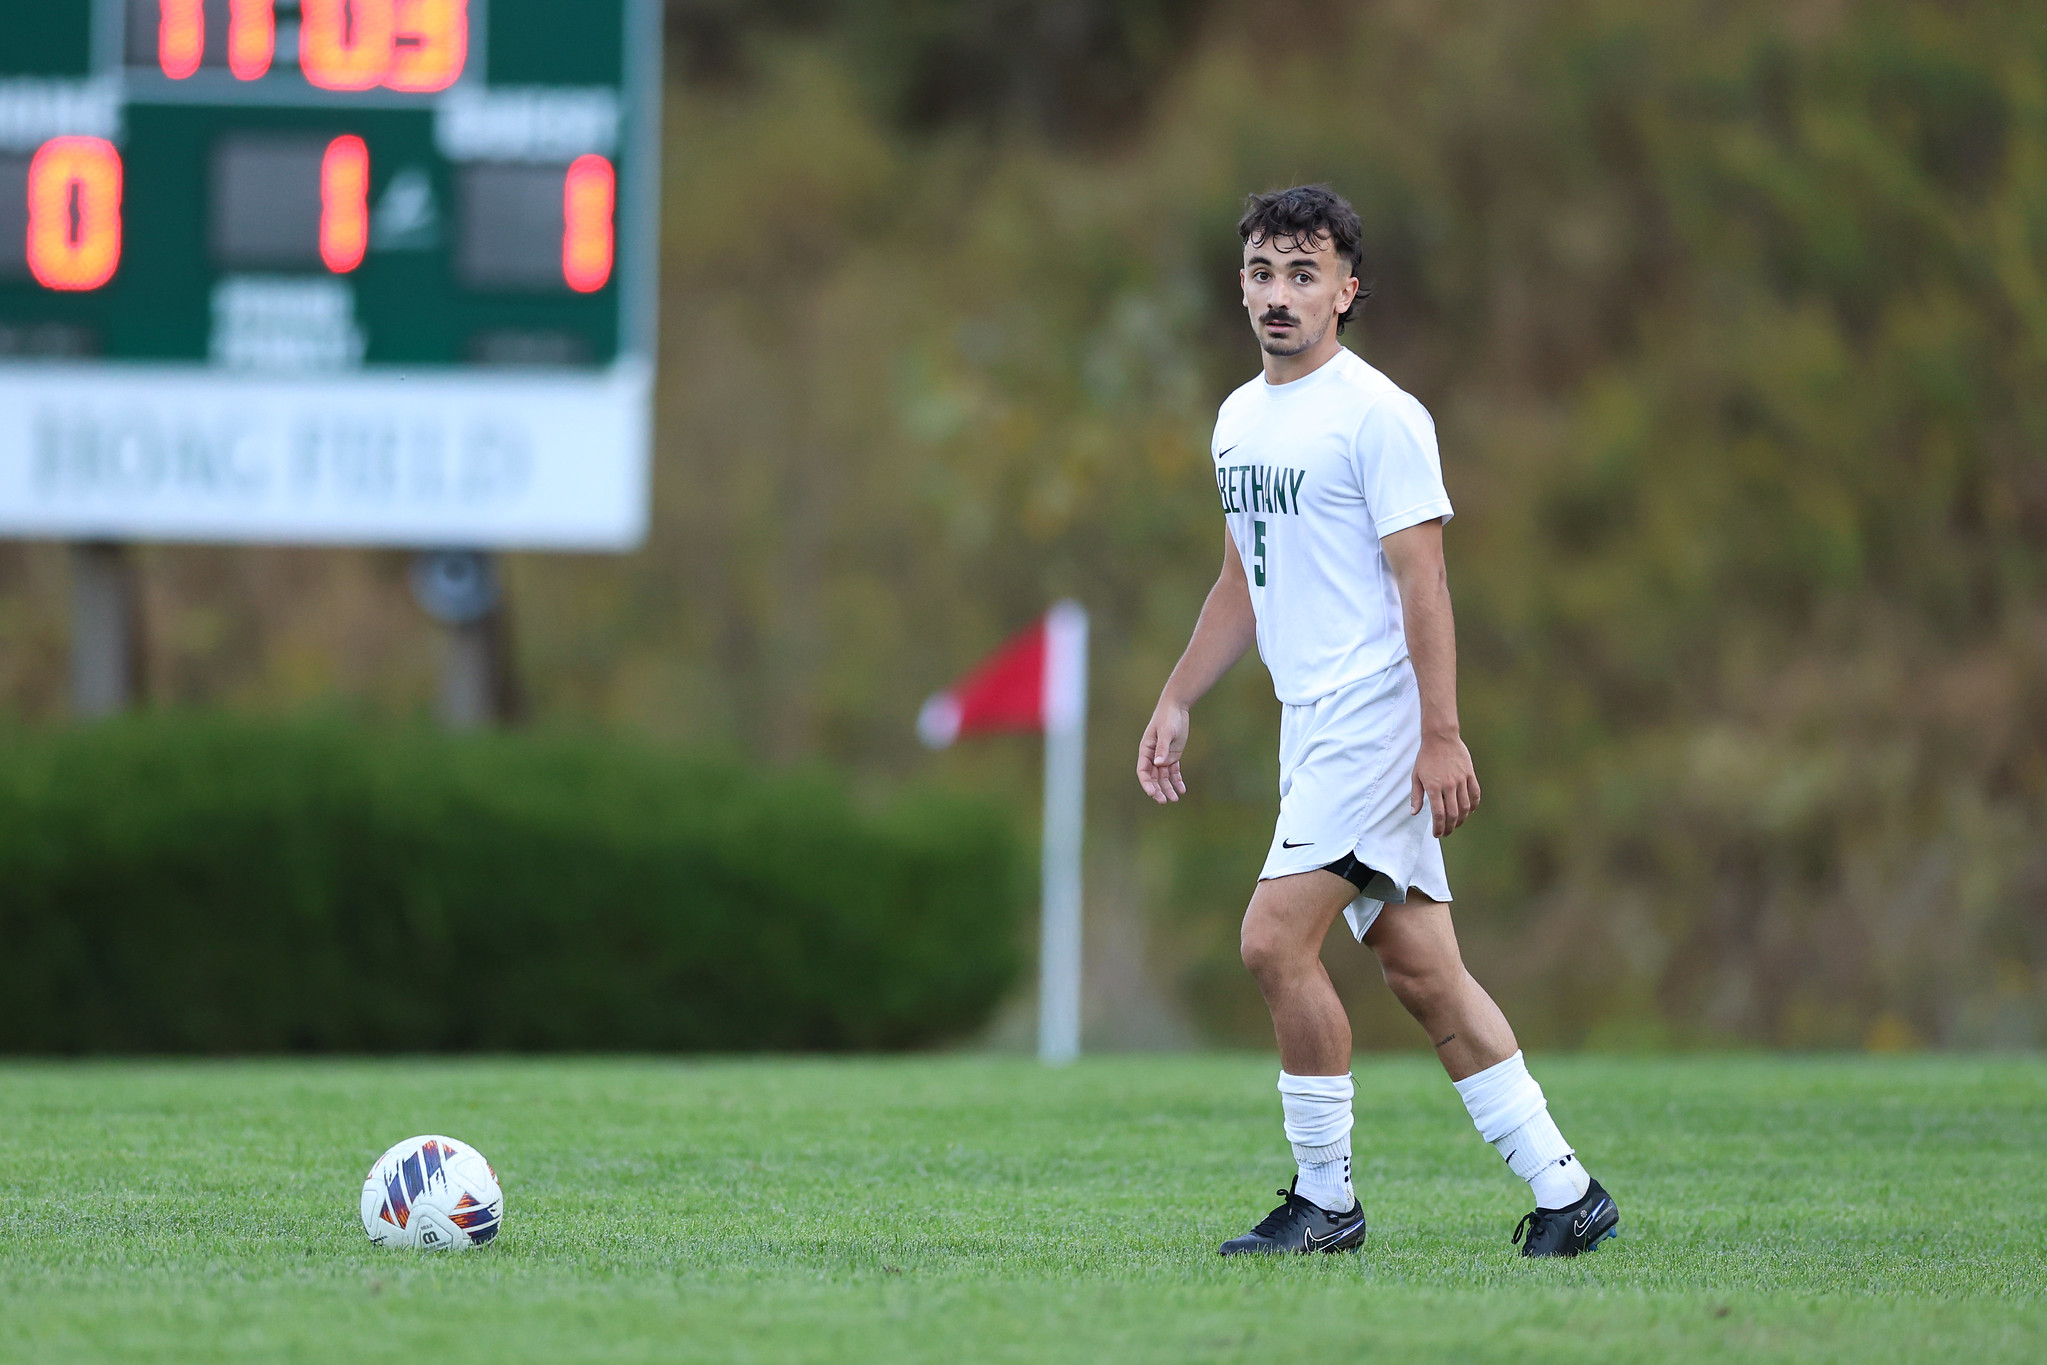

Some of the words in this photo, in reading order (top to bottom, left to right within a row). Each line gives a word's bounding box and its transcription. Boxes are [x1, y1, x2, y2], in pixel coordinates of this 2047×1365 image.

[27, 136, 123, 291] 0
[320, 134, 369, 274] 1
[562, 153, 615, 293] 1
[1218, 465, 1306, 515] BETHANY
[1254, 520, 1266, 587] 5
